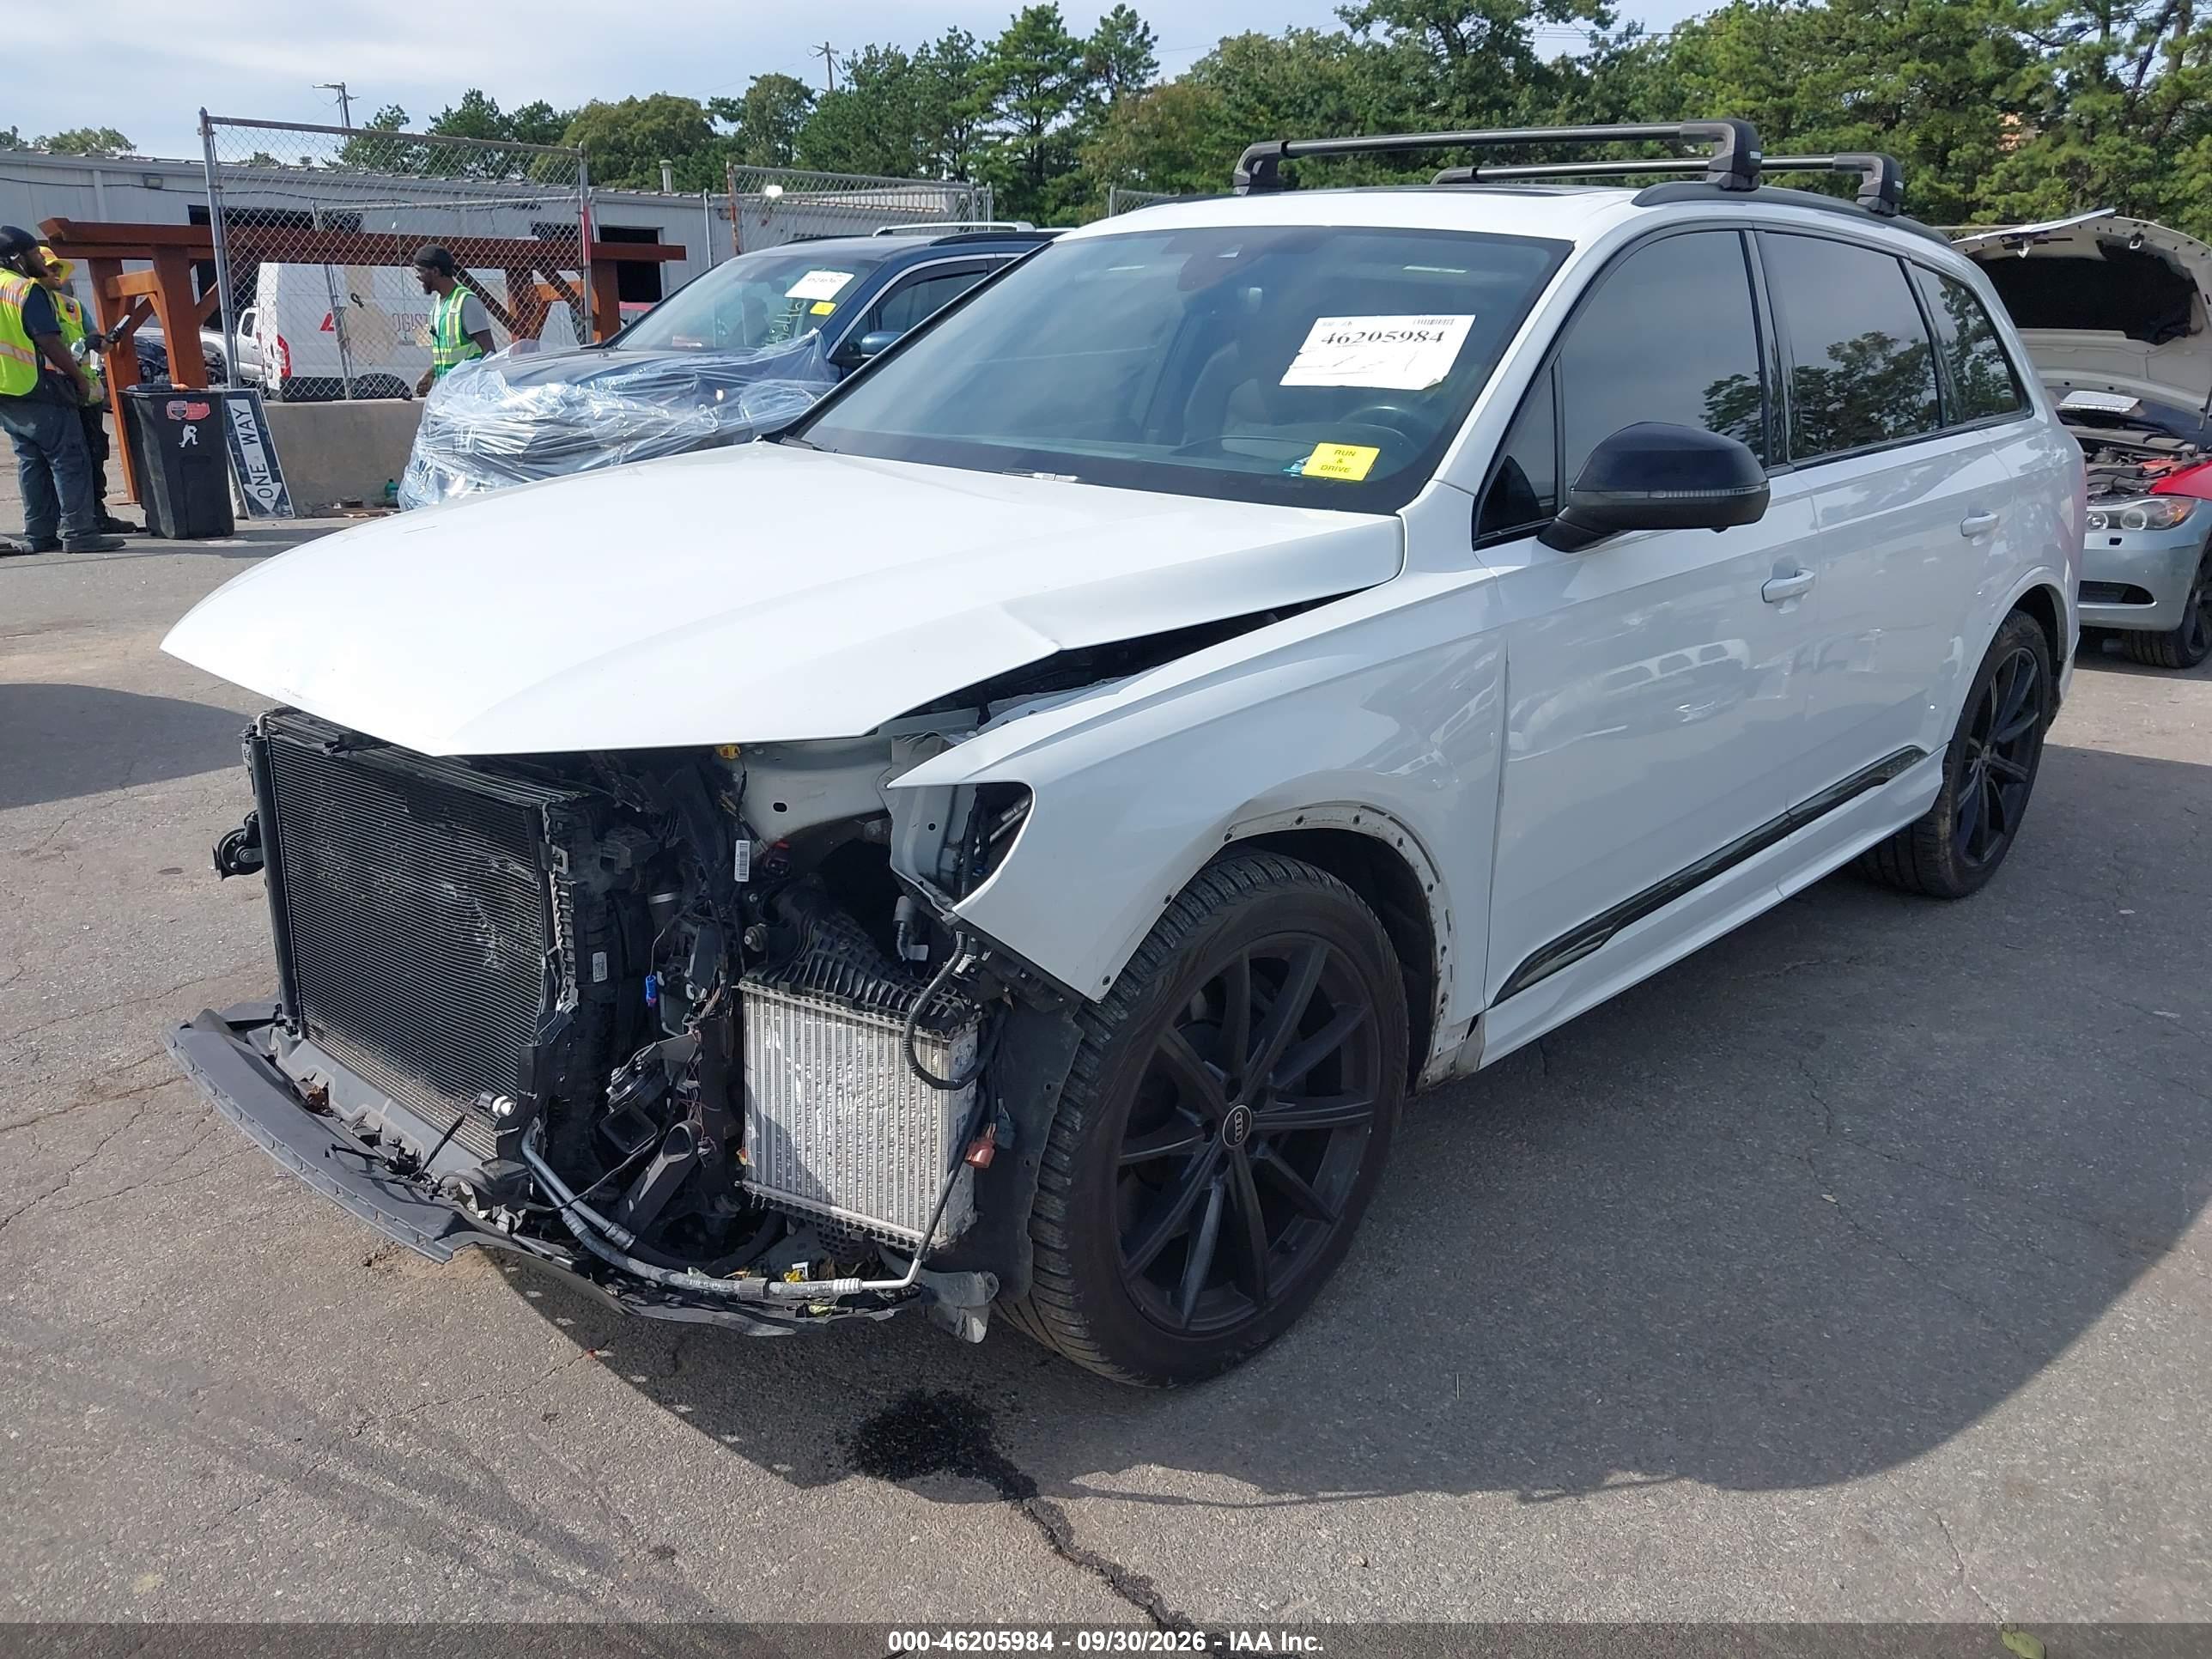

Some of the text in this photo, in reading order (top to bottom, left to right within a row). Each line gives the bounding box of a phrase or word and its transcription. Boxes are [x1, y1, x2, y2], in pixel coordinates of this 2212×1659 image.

[1321, 330, 1444, 344] 46205984
[233, 407, 274, 499] ONE WAY
[1320, 465, 1352, 473] DRIVE
